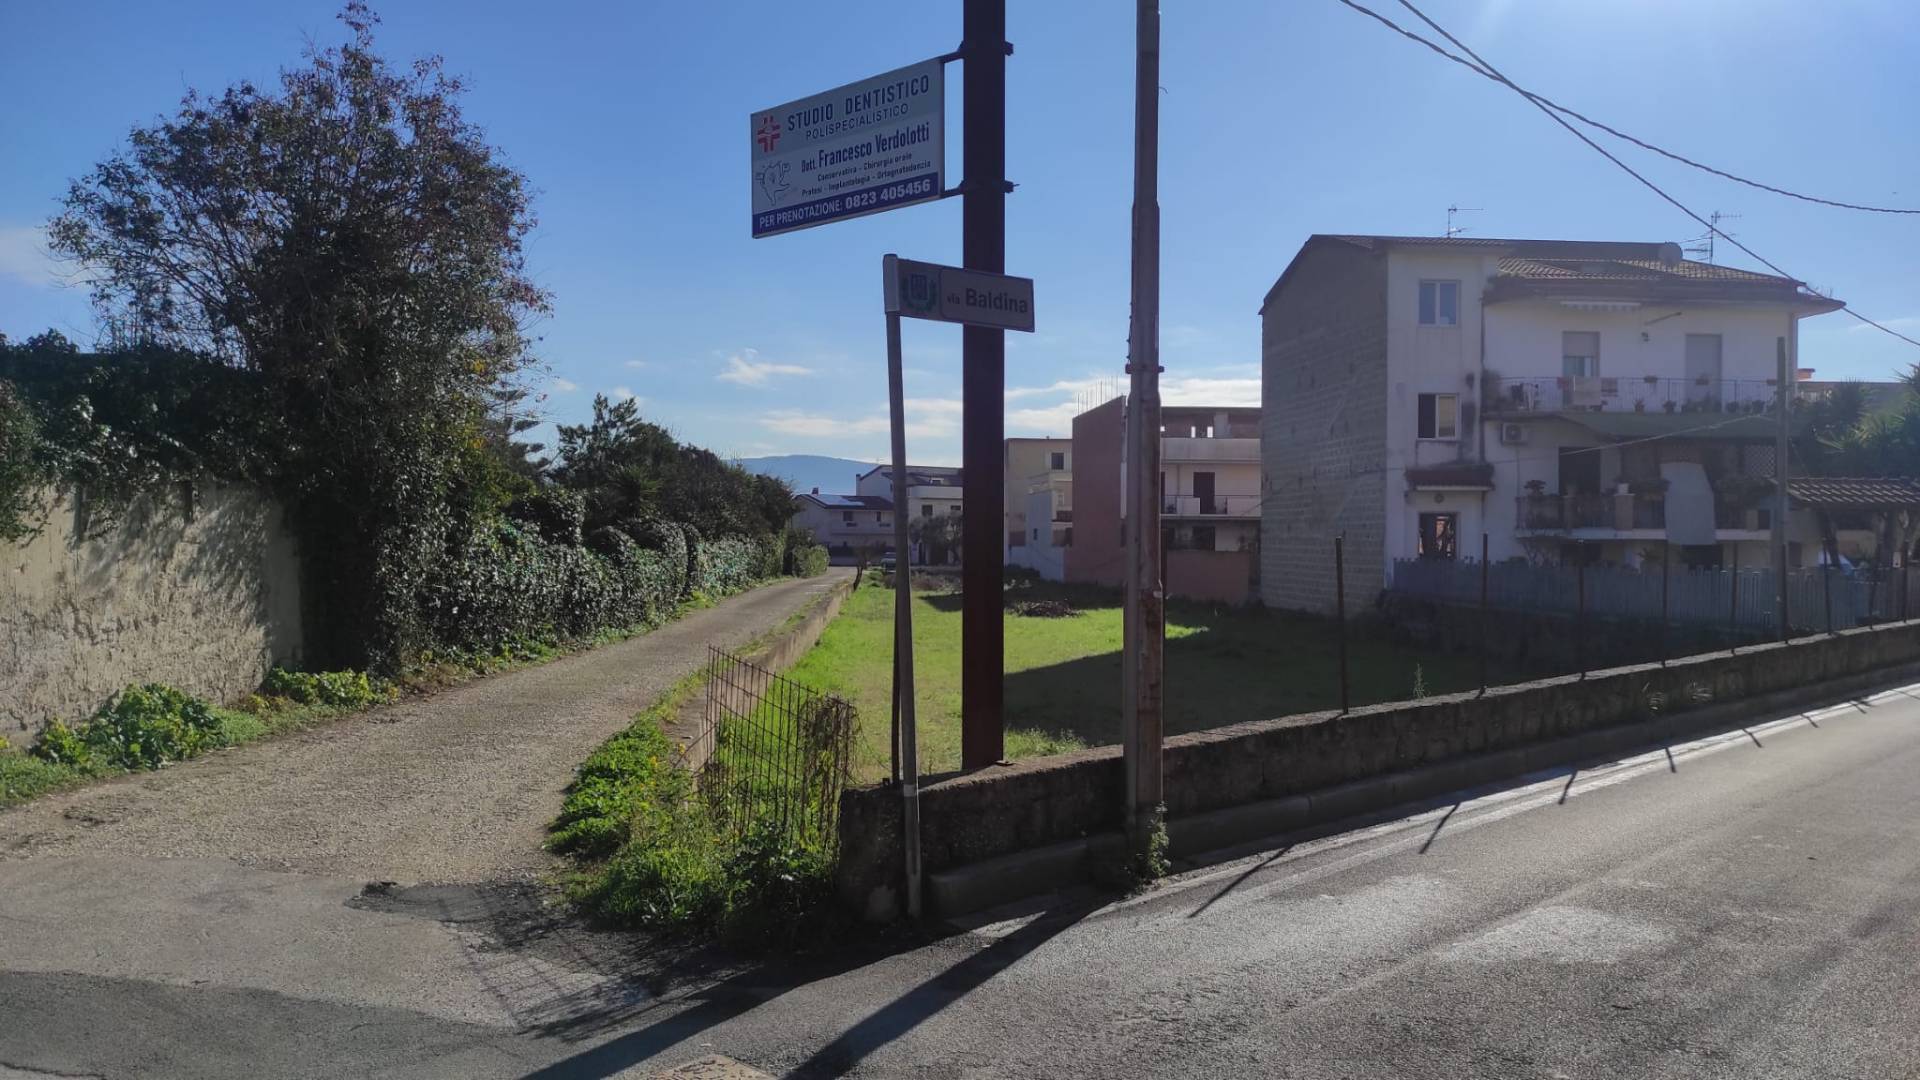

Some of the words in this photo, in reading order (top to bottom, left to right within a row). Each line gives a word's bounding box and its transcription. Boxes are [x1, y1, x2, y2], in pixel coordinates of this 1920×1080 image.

[788, 103, 833, 131] STUDIO
[845, 75, 929, 115] DENTISTICO
[806, 103, 908, 140] POLISPECIALISTICO
[819, 142, 872, 168] Francesco
[875, 122, 929, 153] Verdolotti
[863, 157, 893, 171] Chirurgia
[759, 213, 775, 228] PER
[777, 200, 843, 225] PRENOTAZIONE:
[845, 191, 876, 209] 0823
[880, 179, 931, 200] 405456
[947, 293, 960, 305] via
[966, 287, 1028, 313] Baldina
